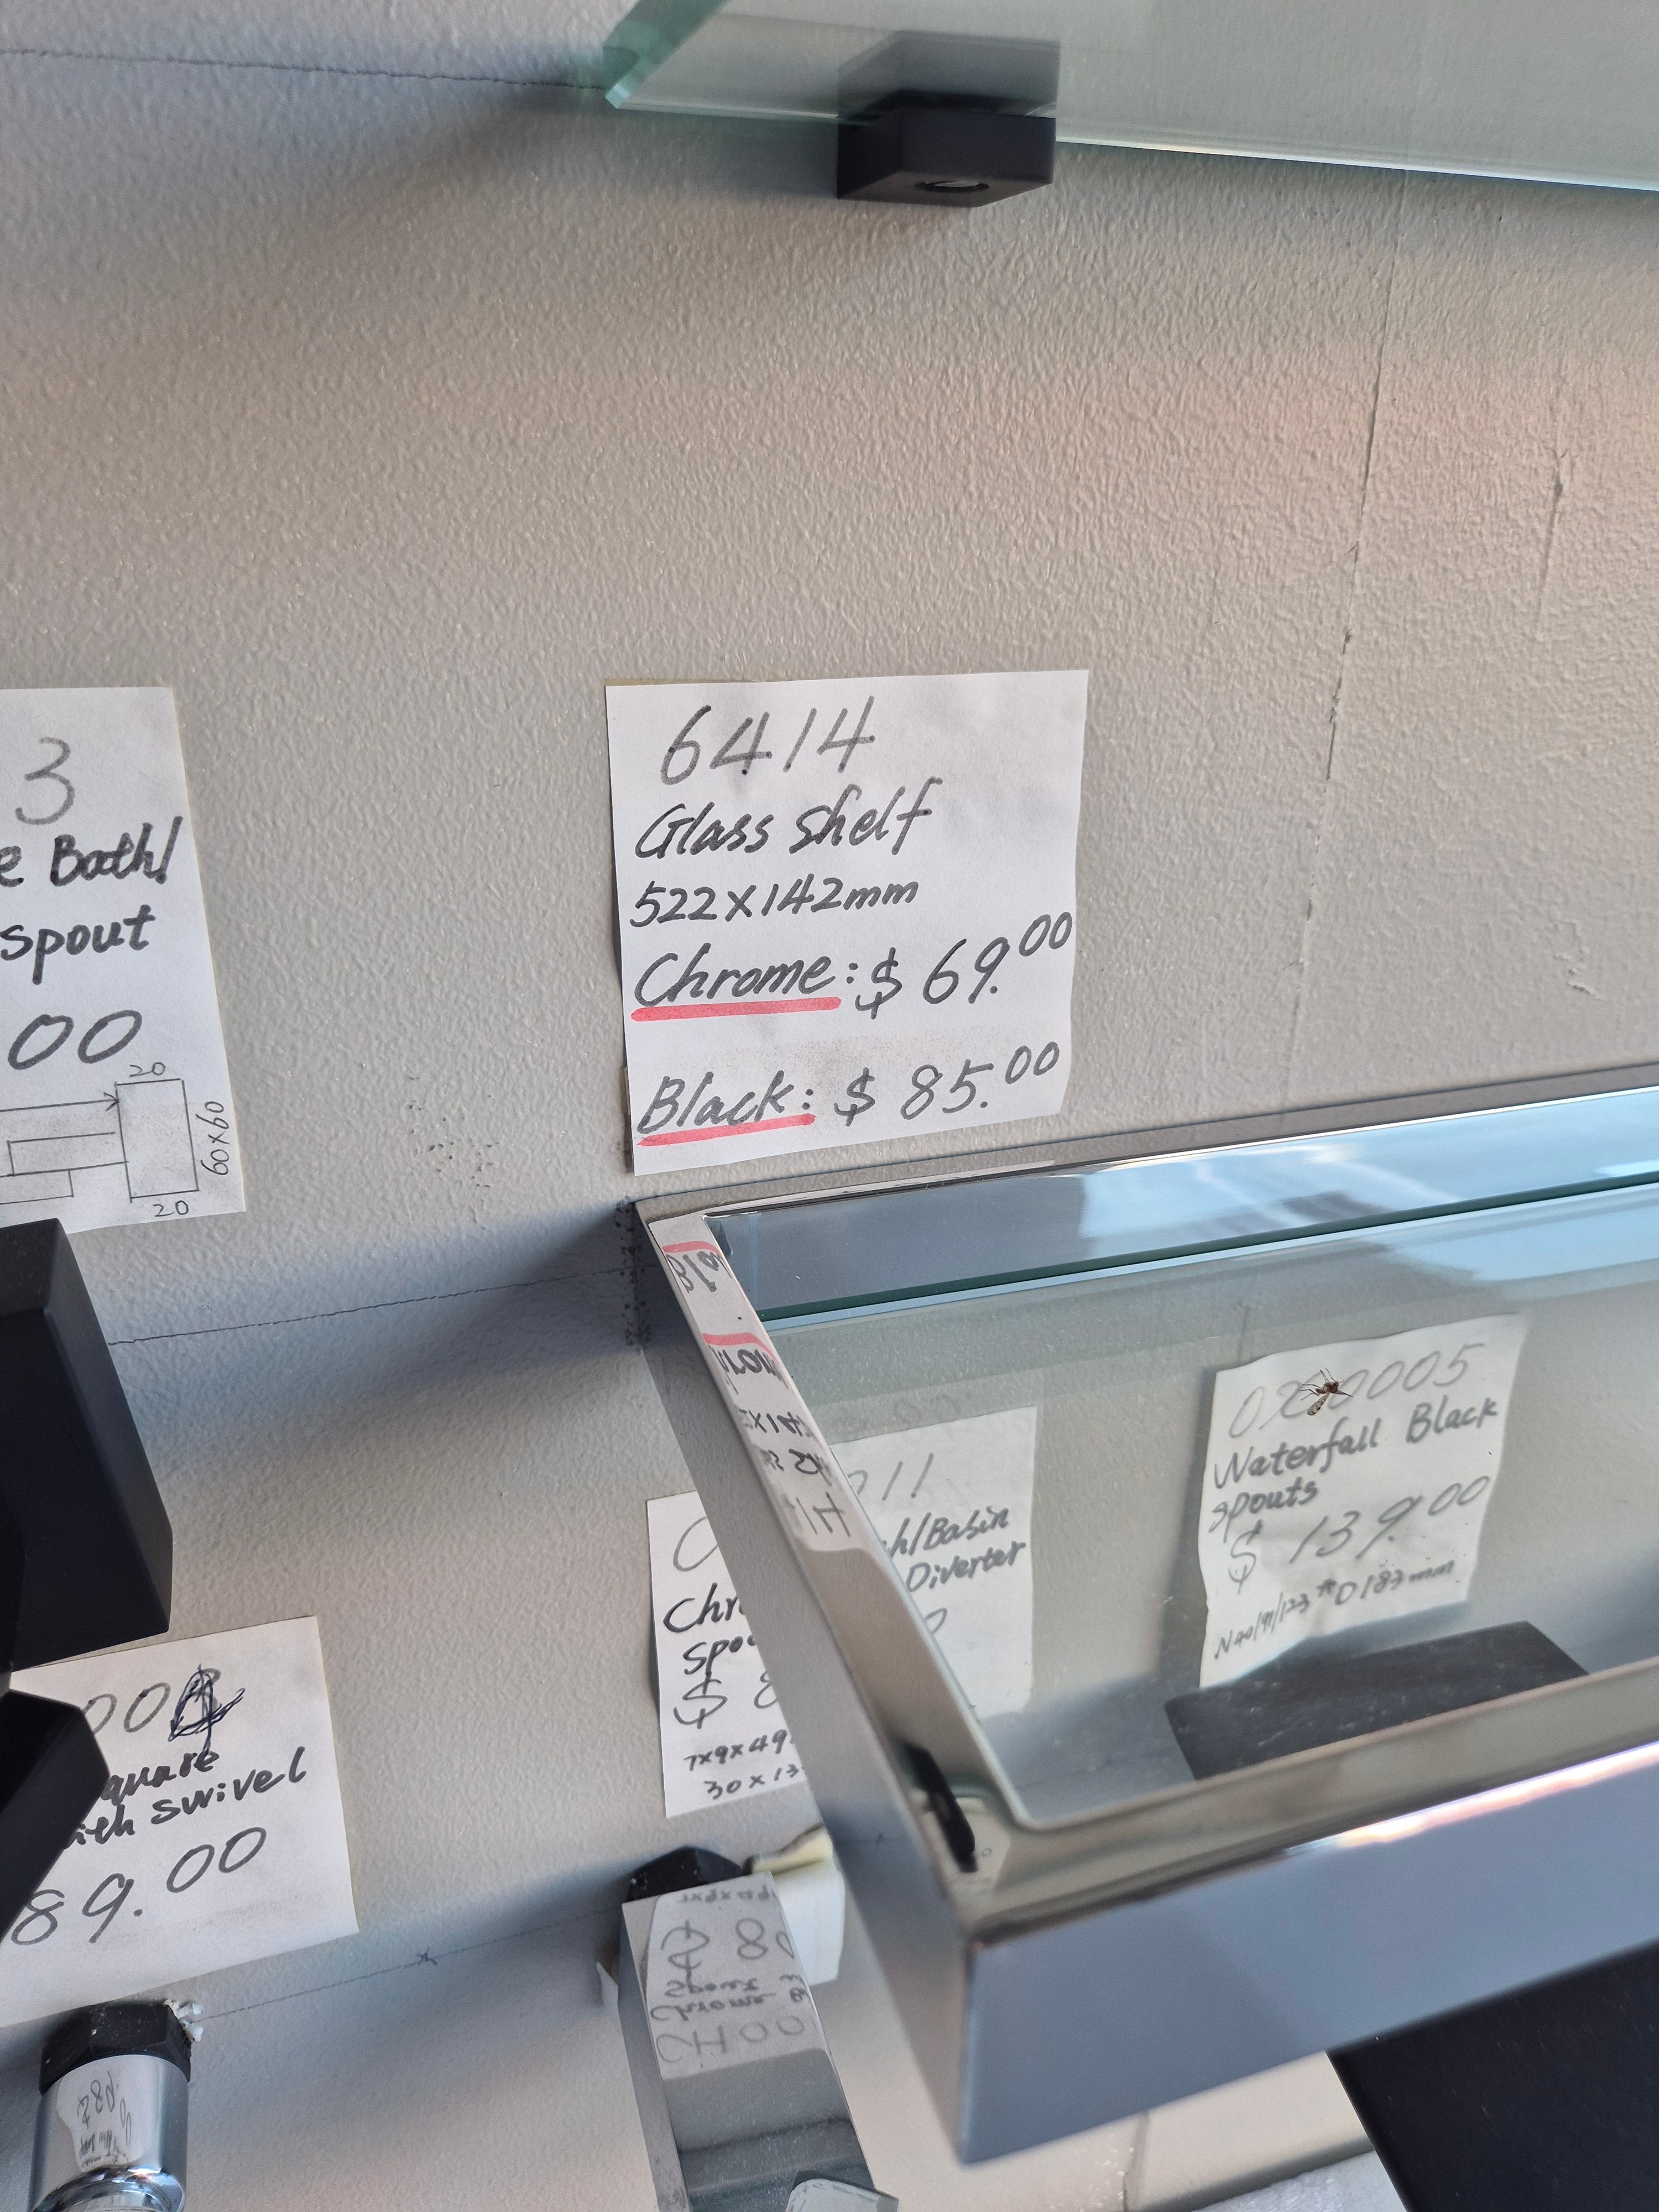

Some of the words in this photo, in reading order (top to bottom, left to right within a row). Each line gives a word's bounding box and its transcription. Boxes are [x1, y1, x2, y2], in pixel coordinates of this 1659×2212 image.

[660, 696, 875, 785] 6414
[15, 736, 76, 826] 3
[634, 801, 775, 859] Glass
[0, 904, 156, 985] spout
[7, 1009, 143, 1070] 00
[129, 1062, 165, 1077] 20
[152, 1200, 189, 1217] 20
[1214, 1417, 1379, 1490] Waterfall
[1405, 1395, 1498, 1444] Black
[663, 1582, 744, 1633] Chr
[65, 1804, 135, 1845] ith
[150, 1746, 307, 1824] swivel
[101, 1751, 220, 1806] quare
